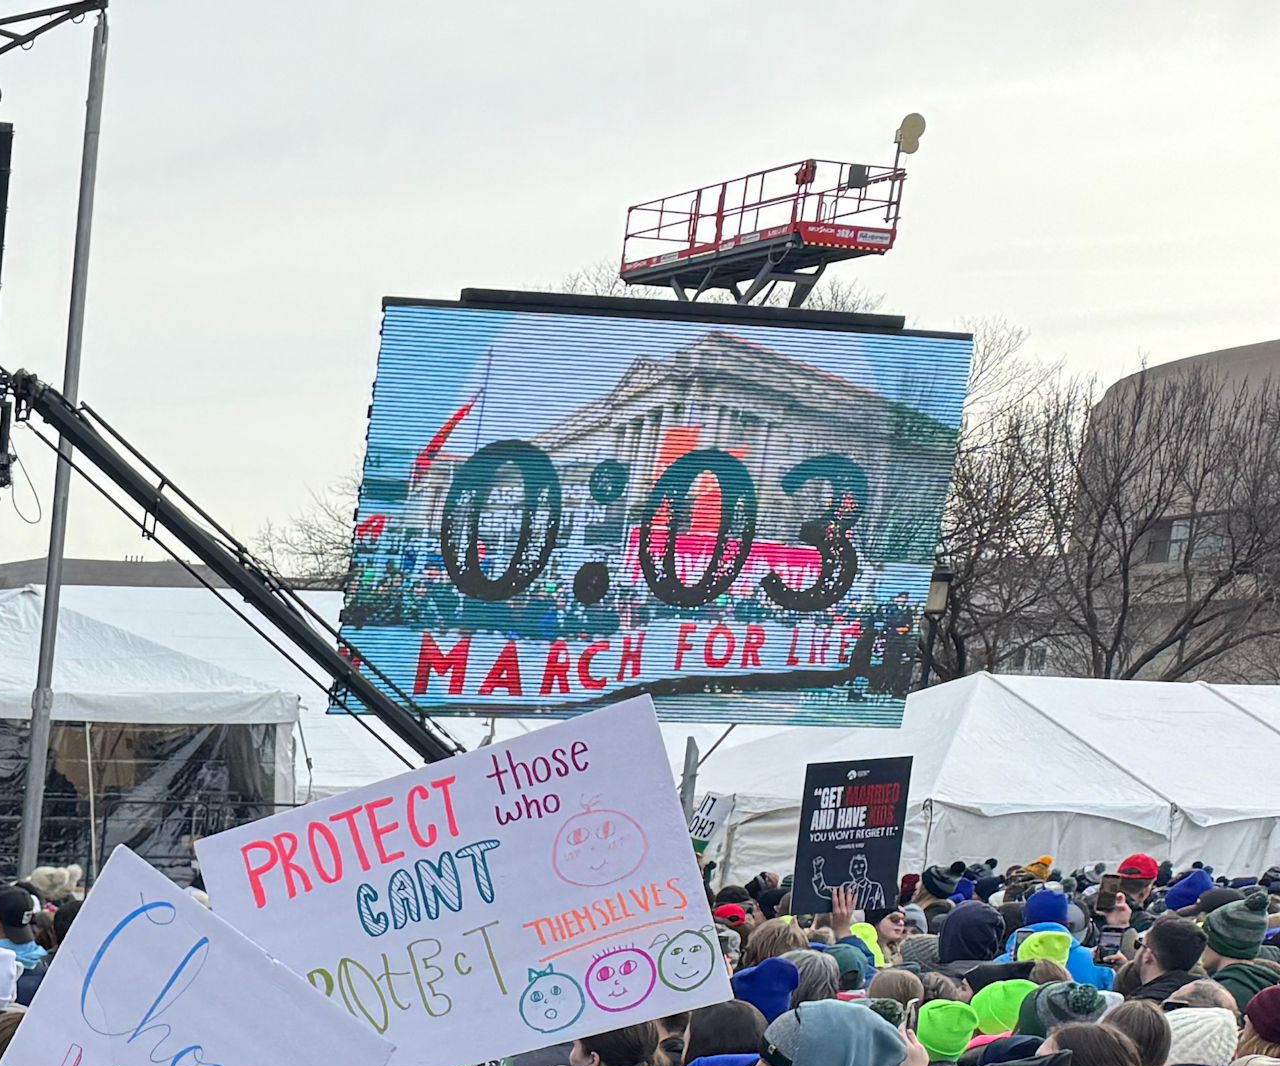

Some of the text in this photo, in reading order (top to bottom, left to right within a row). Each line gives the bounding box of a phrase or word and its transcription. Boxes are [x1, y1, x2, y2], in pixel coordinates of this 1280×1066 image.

[440, 438, 870, 612] 0:03
[412, 631, 647, 698] MARCH
[673, 623, 766, 672] FOR
[240, 740, 590, 910] PROTECT those
[494, 793, 561, 827] who
[809, 809, 836, 831] AND
[836, 805, 868, 829] HAVE
[356, 838, 501, 938] CANT
[521, 877, 688, 946] THEMSELVES
